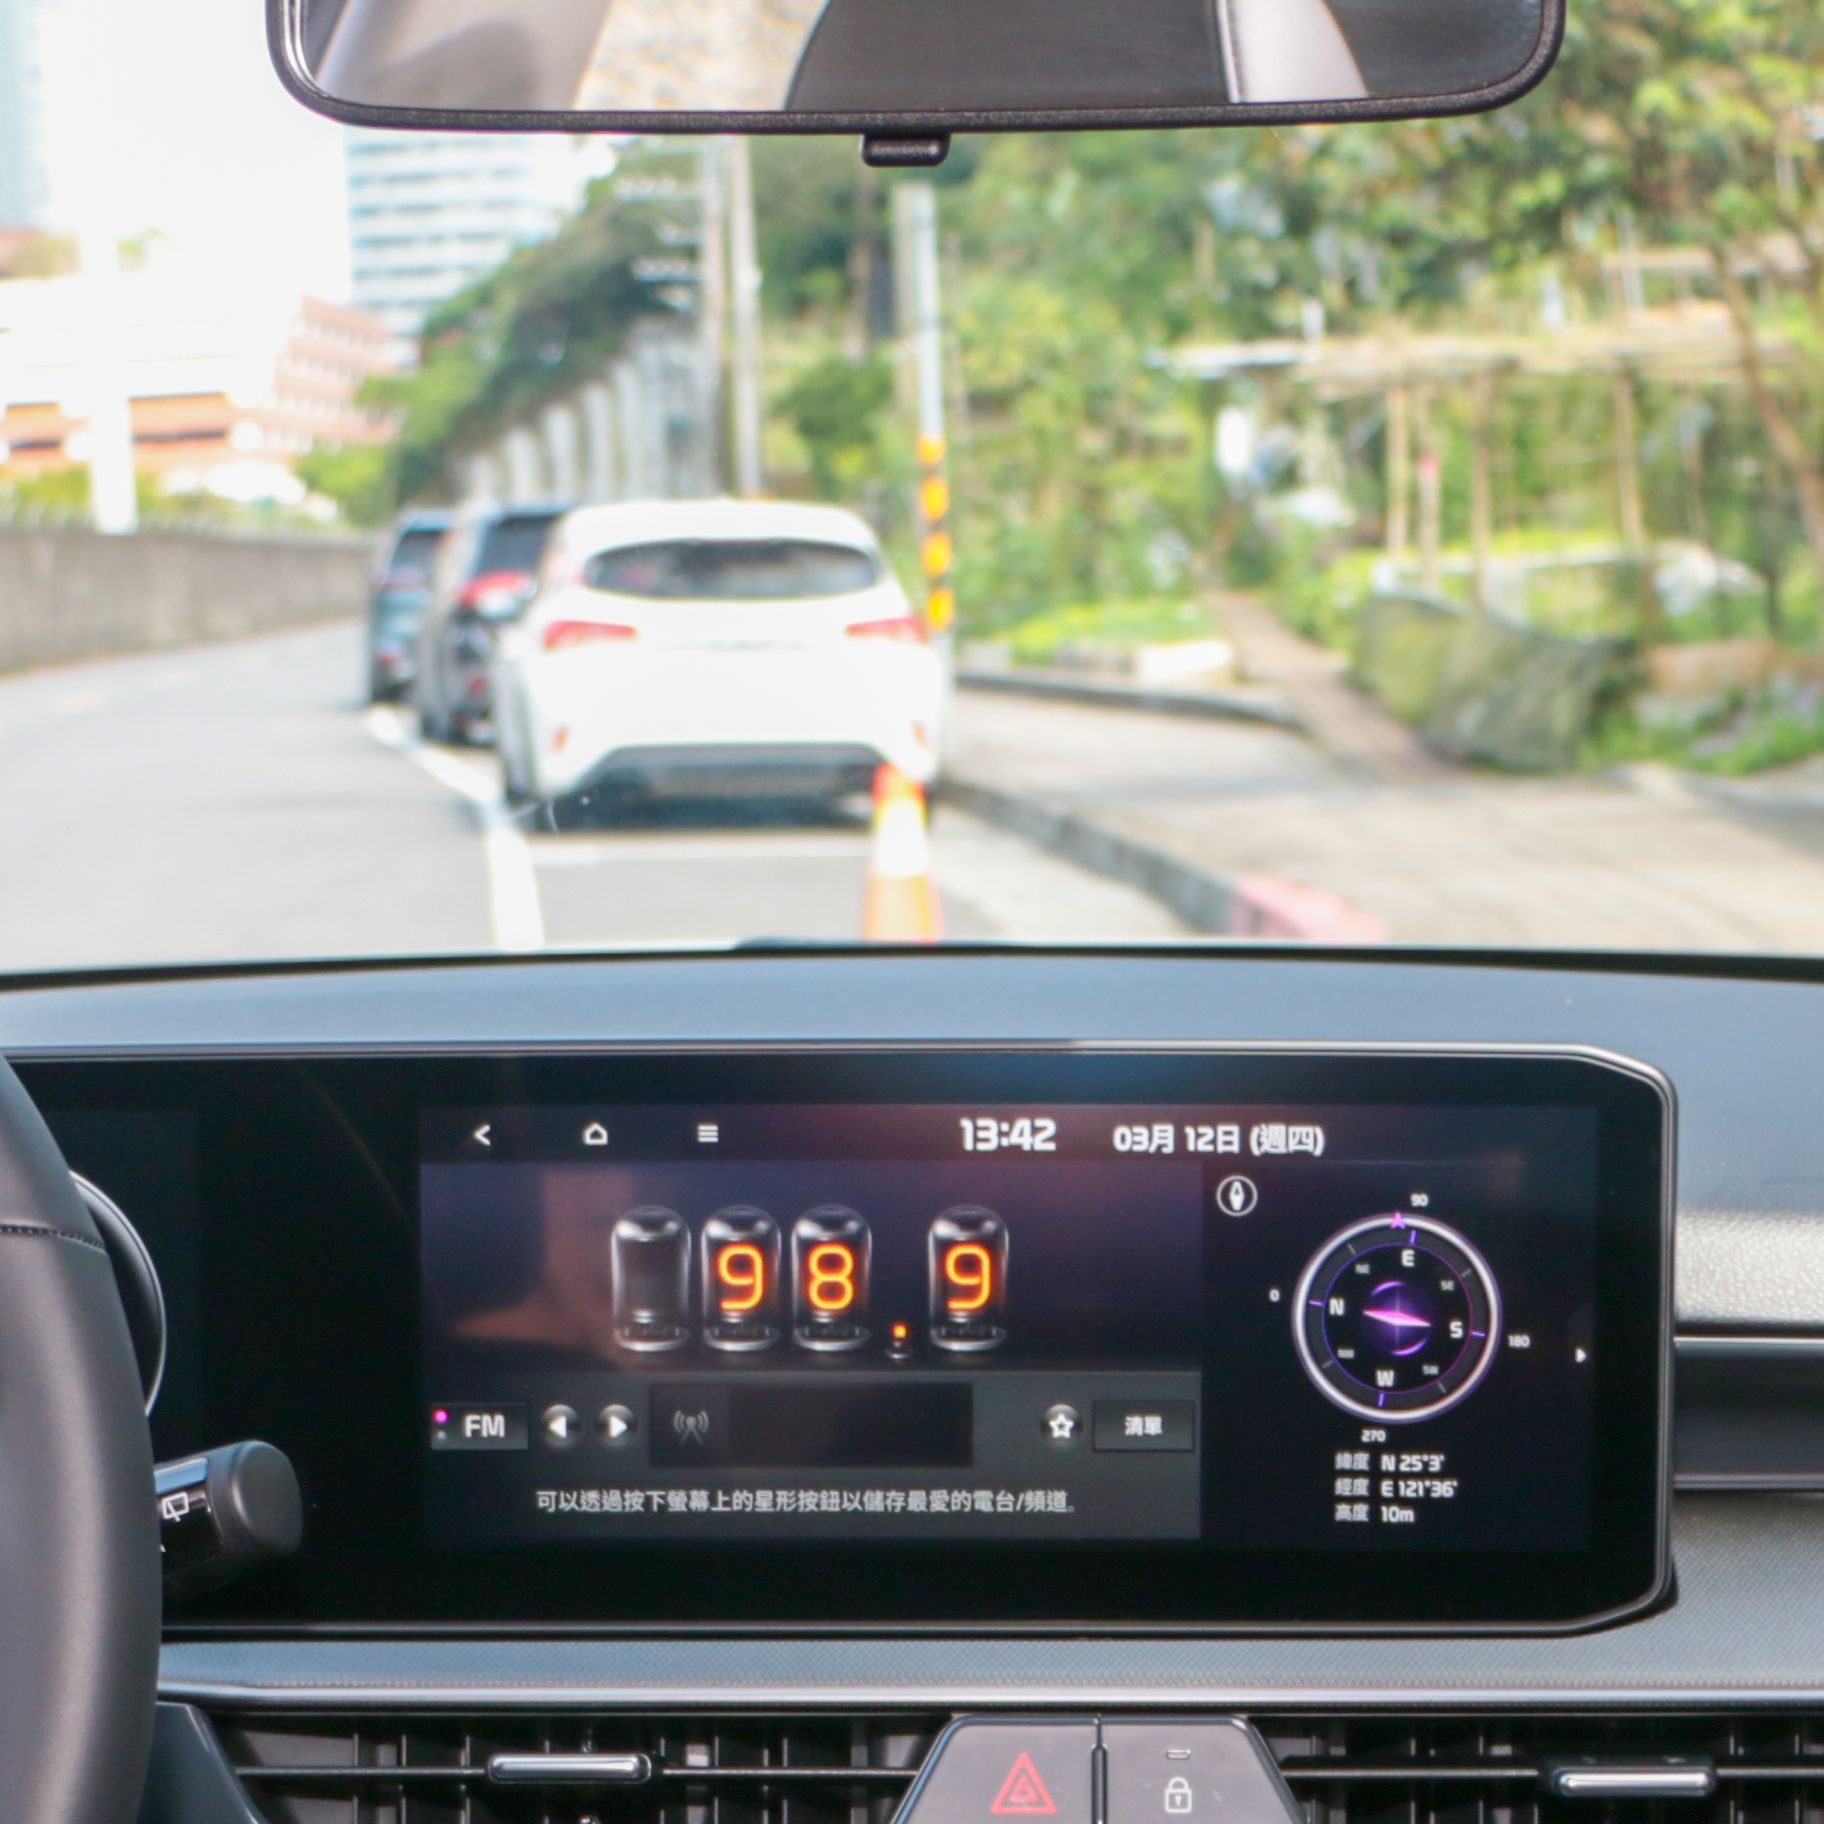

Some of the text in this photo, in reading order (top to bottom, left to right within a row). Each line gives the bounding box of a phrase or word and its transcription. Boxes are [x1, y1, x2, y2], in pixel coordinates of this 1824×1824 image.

[960, 1118, 1056, 1150] 13:42
[1113, 1123, 1325, 1156] 03月 12日 (週四)
[1411, 1194, 1428, 1206] 90
[1402, 1249, 1414, 1267] E
[1355, 1263, 1370, 1274] NE
[716, 1243, 993, 1339] 98.9
[1270, 1289, 1280, 1301] 0
[1330, 1298, 1344, 1315] N
[1450, 1321, 1463, 1338] S
[1509, 1335, 1530, 1348] 180
[1377, 1370, 1394, 1386] W
[465, 1415, 504, 1437] FM
[1125, 1416, 1162, 1436] 清單
[1362, 1429, 1386, 1442] 270
[1336, 1452, 1369, 1470] 緯度
[1382, 1455, 1396, 1471] N
[1335, 1478, 1369, 1496] 經度
[1381, 1480, 1393, 1497] E
[1336, 1503, 1369, 1521] 高度
[1381, 1506, 1414, 1522] 10m
